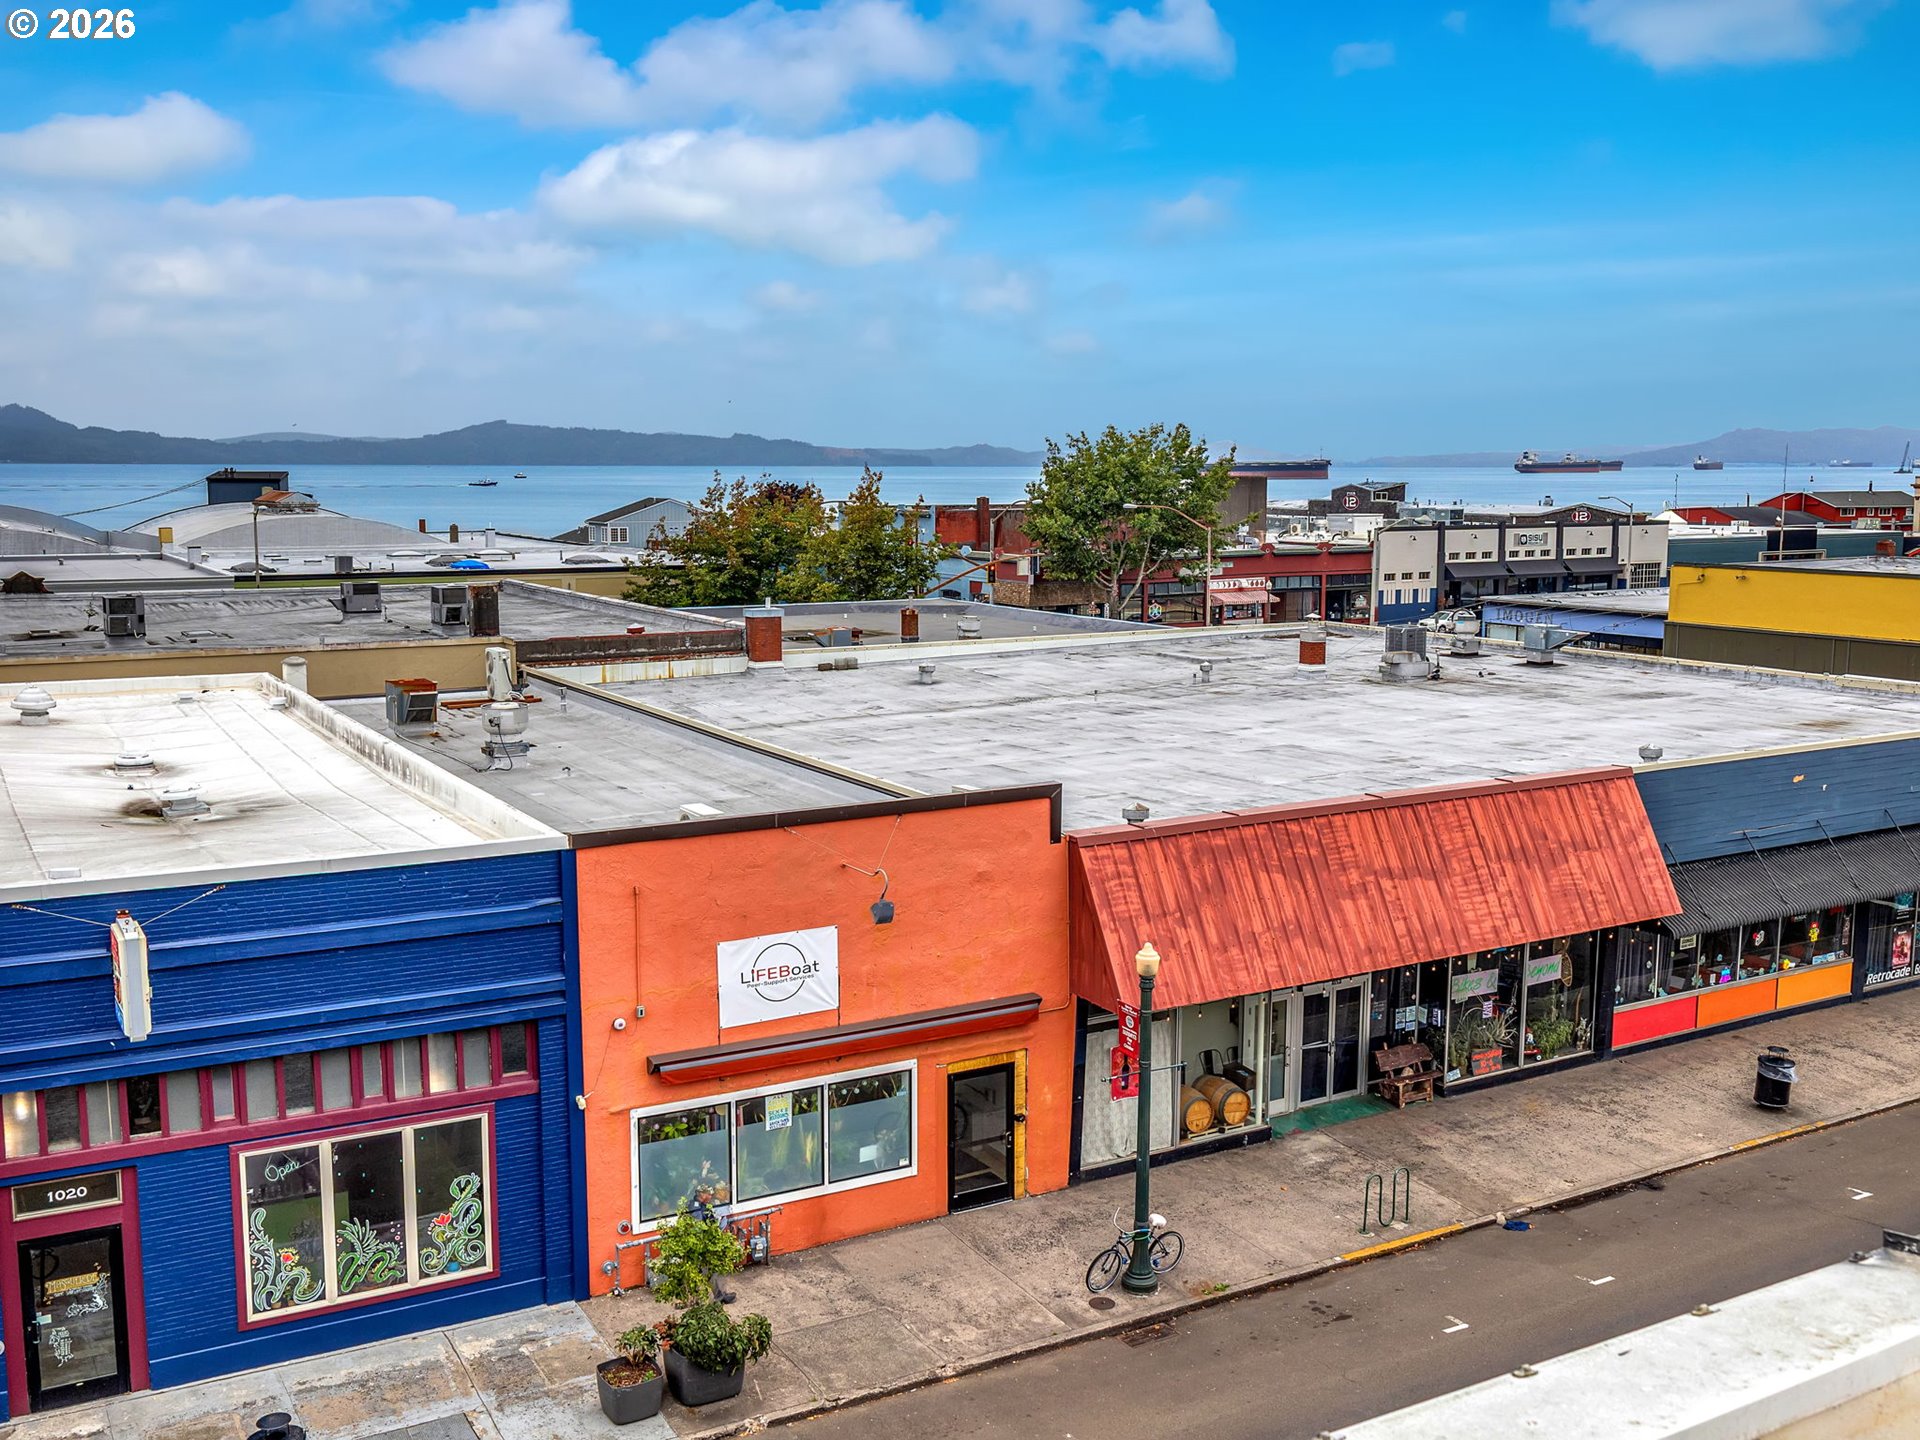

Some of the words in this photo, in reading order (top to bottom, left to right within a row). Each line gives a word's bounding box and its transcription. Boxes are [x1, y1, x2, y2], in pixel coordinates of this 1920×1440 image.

[1345, 496, 1357, 507] 12
[1575, 511, 1588, 521] 12
[1527, 534, 1543, 542] SISU
[1496, 607, 1553, 625] IMOGEN
[746, 977, 788, 989] Peer-Support
[789, 973, 815, 982] Services
[1866, 966, 1911, 985] Retrocade
[265, 1161, 300, 1182] Open
[47, 1186, 88, 1202] 1020
